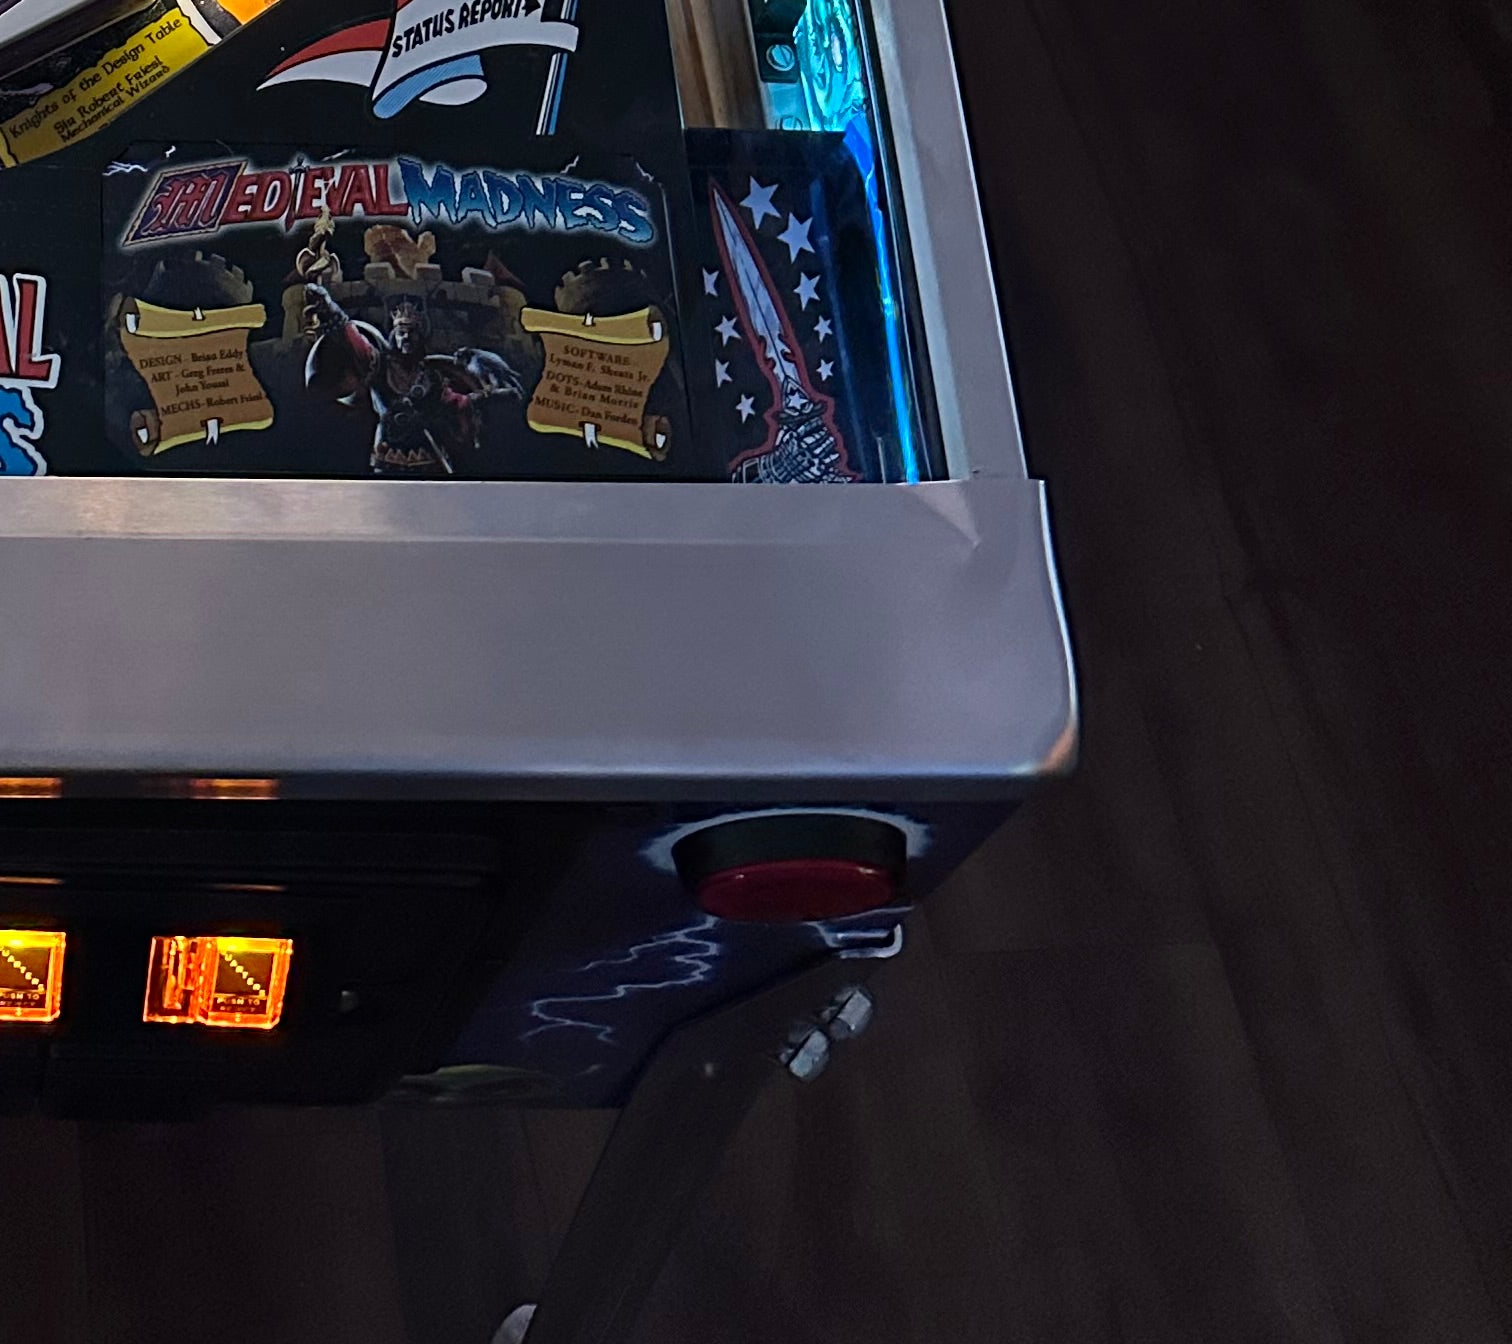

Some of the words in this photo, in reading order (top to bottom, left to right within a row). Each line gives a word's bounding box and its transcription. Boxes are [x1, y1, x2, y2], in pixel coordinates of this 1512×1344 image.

[391, 7, 457, 58] STATUS
[9, 100, 59, 139] Knights
[62, 89, 77, 105] of
[80, 72, 102, 92] the
[101, 43, 145, 73] Design
[144, 17, 183, 45] Table
[54, 115, 76, 135] Sir
[77, 82, 125, 120] Robert
[60, 96, 125, 145] Mechanical
[128, 156, 409, 245] MEDIEVAL
[398, 157, 656, 243] MADNESS
[139, 354, 182, 369] DESIGN
[151, 371, 173, 383] ART
[564, 345, 631, 366] SOFTWARE
